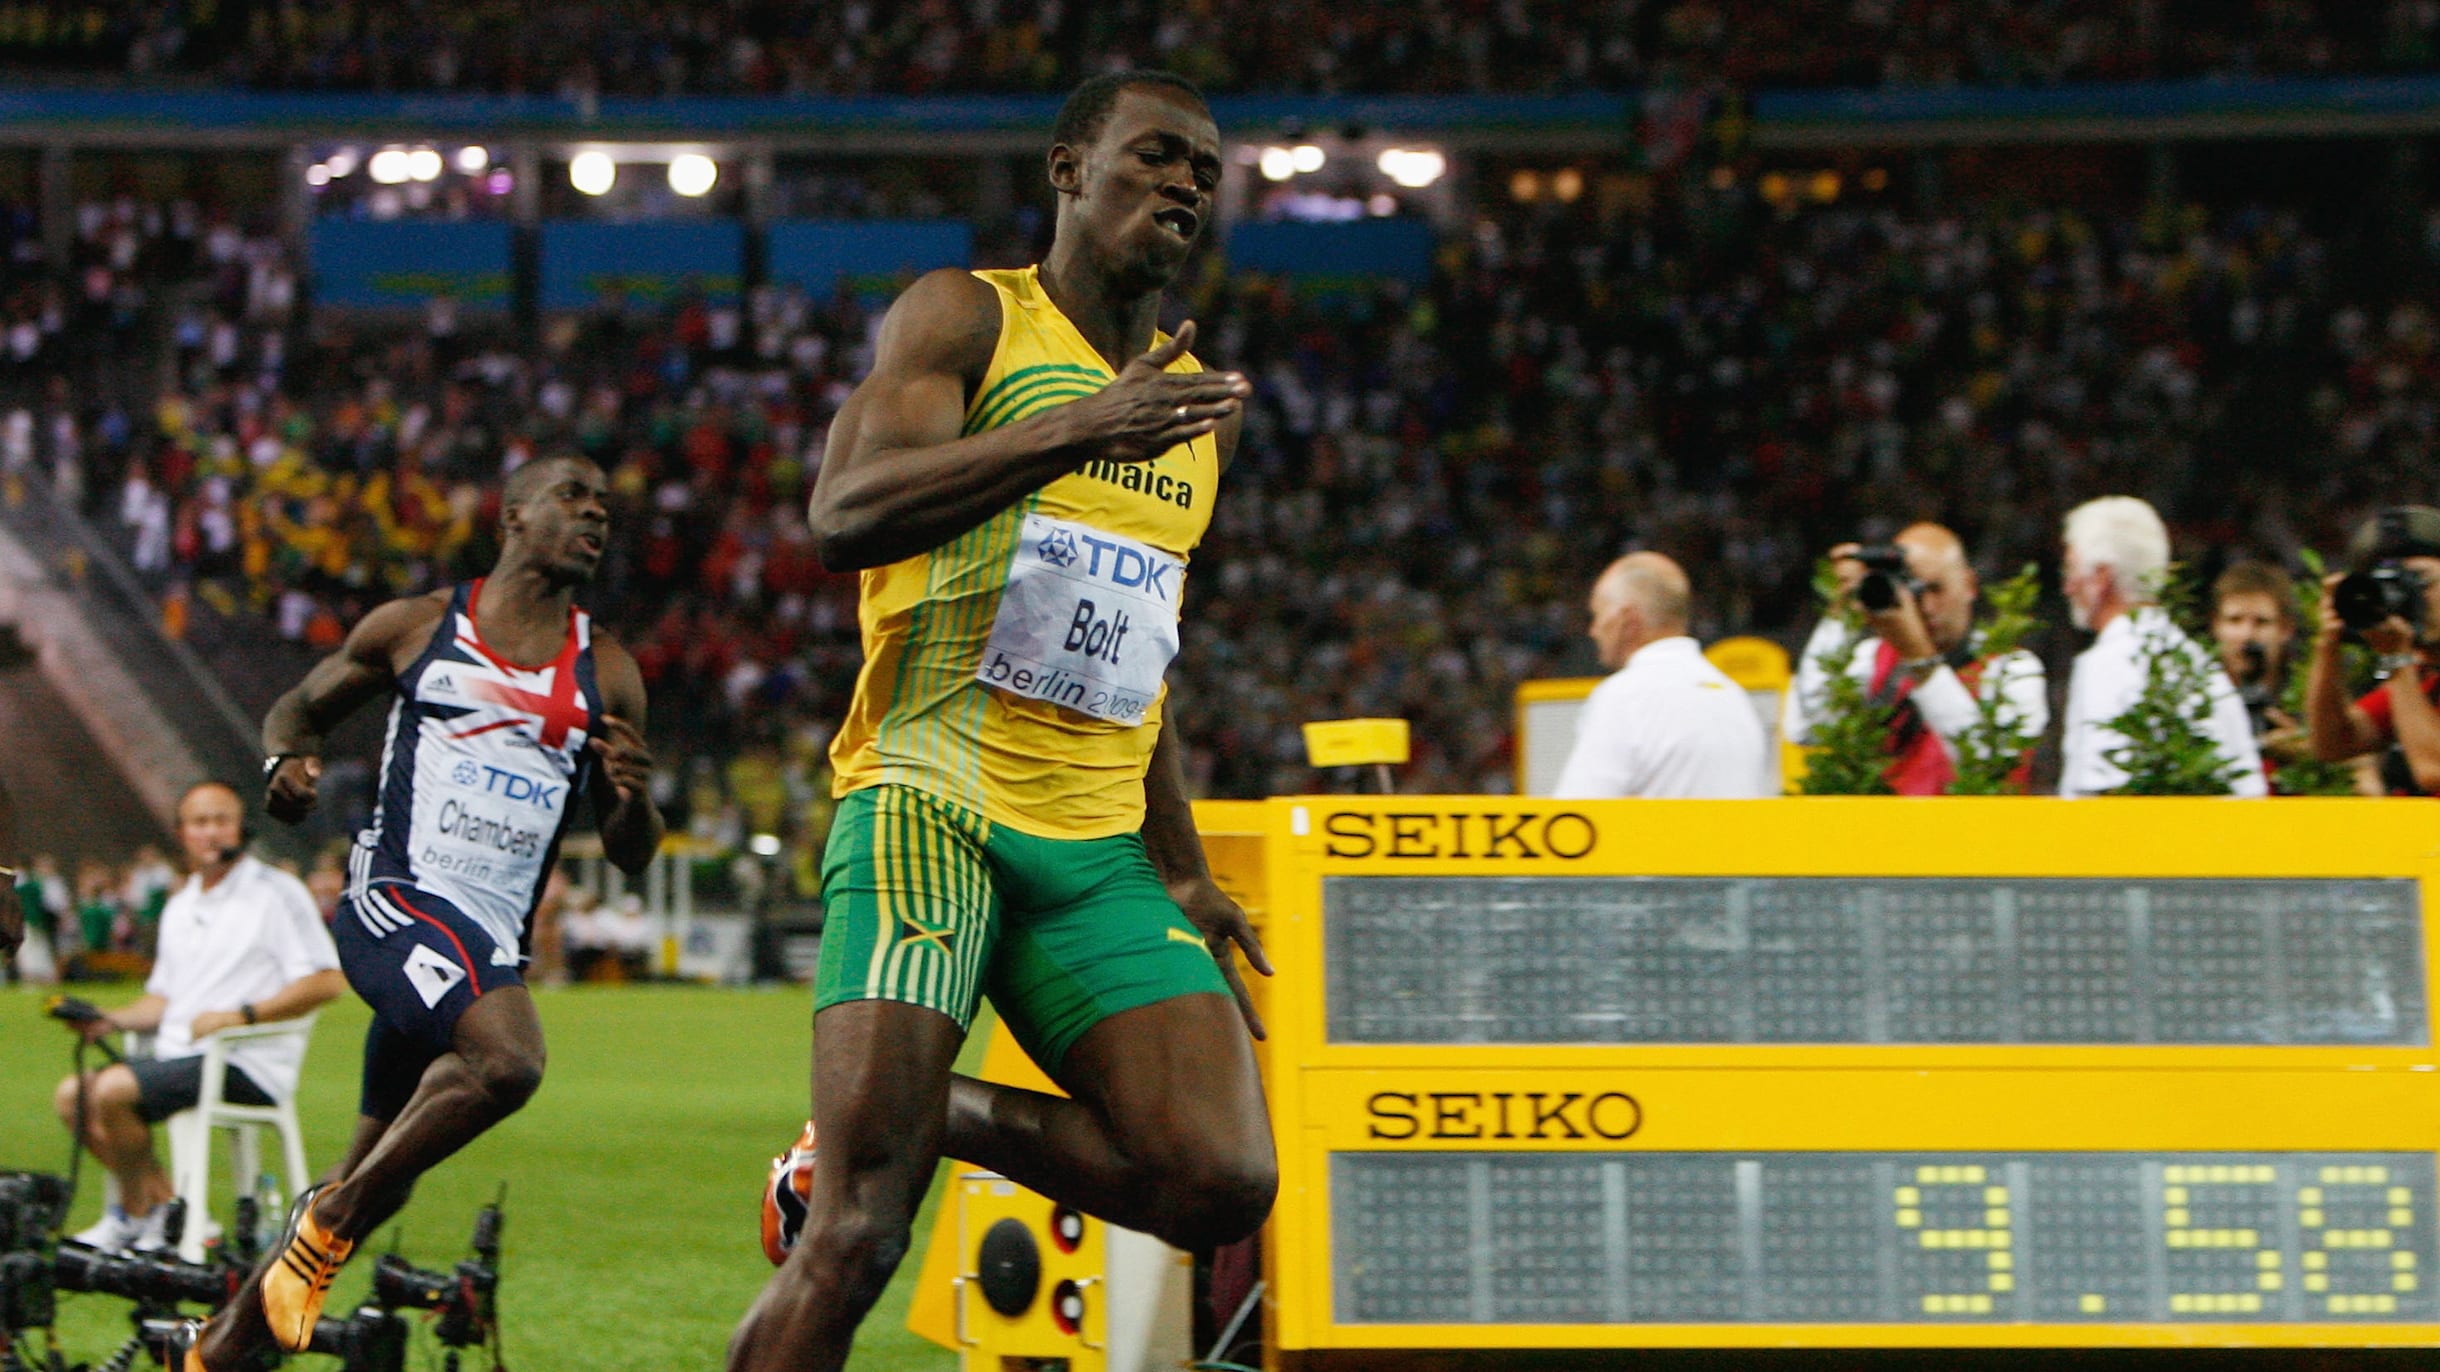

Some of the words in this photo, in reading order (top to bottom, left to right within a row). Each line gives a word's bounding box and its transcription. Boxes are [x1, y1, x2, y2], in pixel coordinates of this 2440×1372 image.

[1076, 459, 1193, 510] maica
[1081, 534, 1173, 602] TDK
[1064, 598, 1130, 665] Bolt
[987, 653, 1086, 705] berlin
[482, 765, 560, 809] TDK
[439, 799, 539, 858] Chambers
[1325, 812, 1597, 861] SEIKO
[422, 846, 491, 877] berlin
[1368, 1091, 1642, 1141] SEIKO
[1895, 1166, 2414, 1312] 9.58
